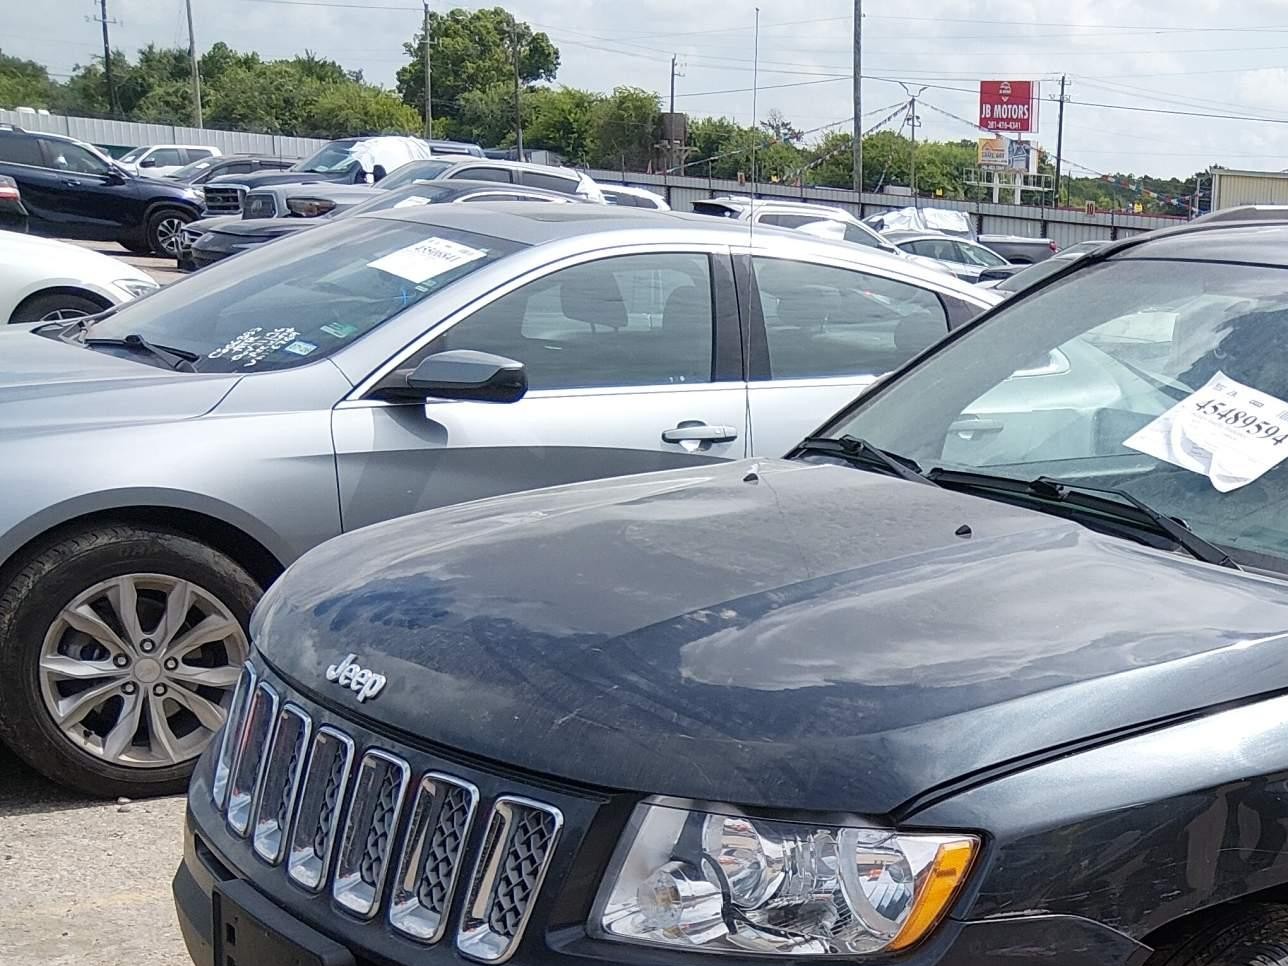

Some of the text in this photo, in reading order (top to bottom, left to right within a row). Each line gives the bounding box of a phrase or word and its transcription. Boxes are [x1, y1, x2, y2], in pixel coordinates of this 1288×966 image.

[982, 104, 1029, 119] JB MOTORS
[326, 653, 387, 703] Jeep
